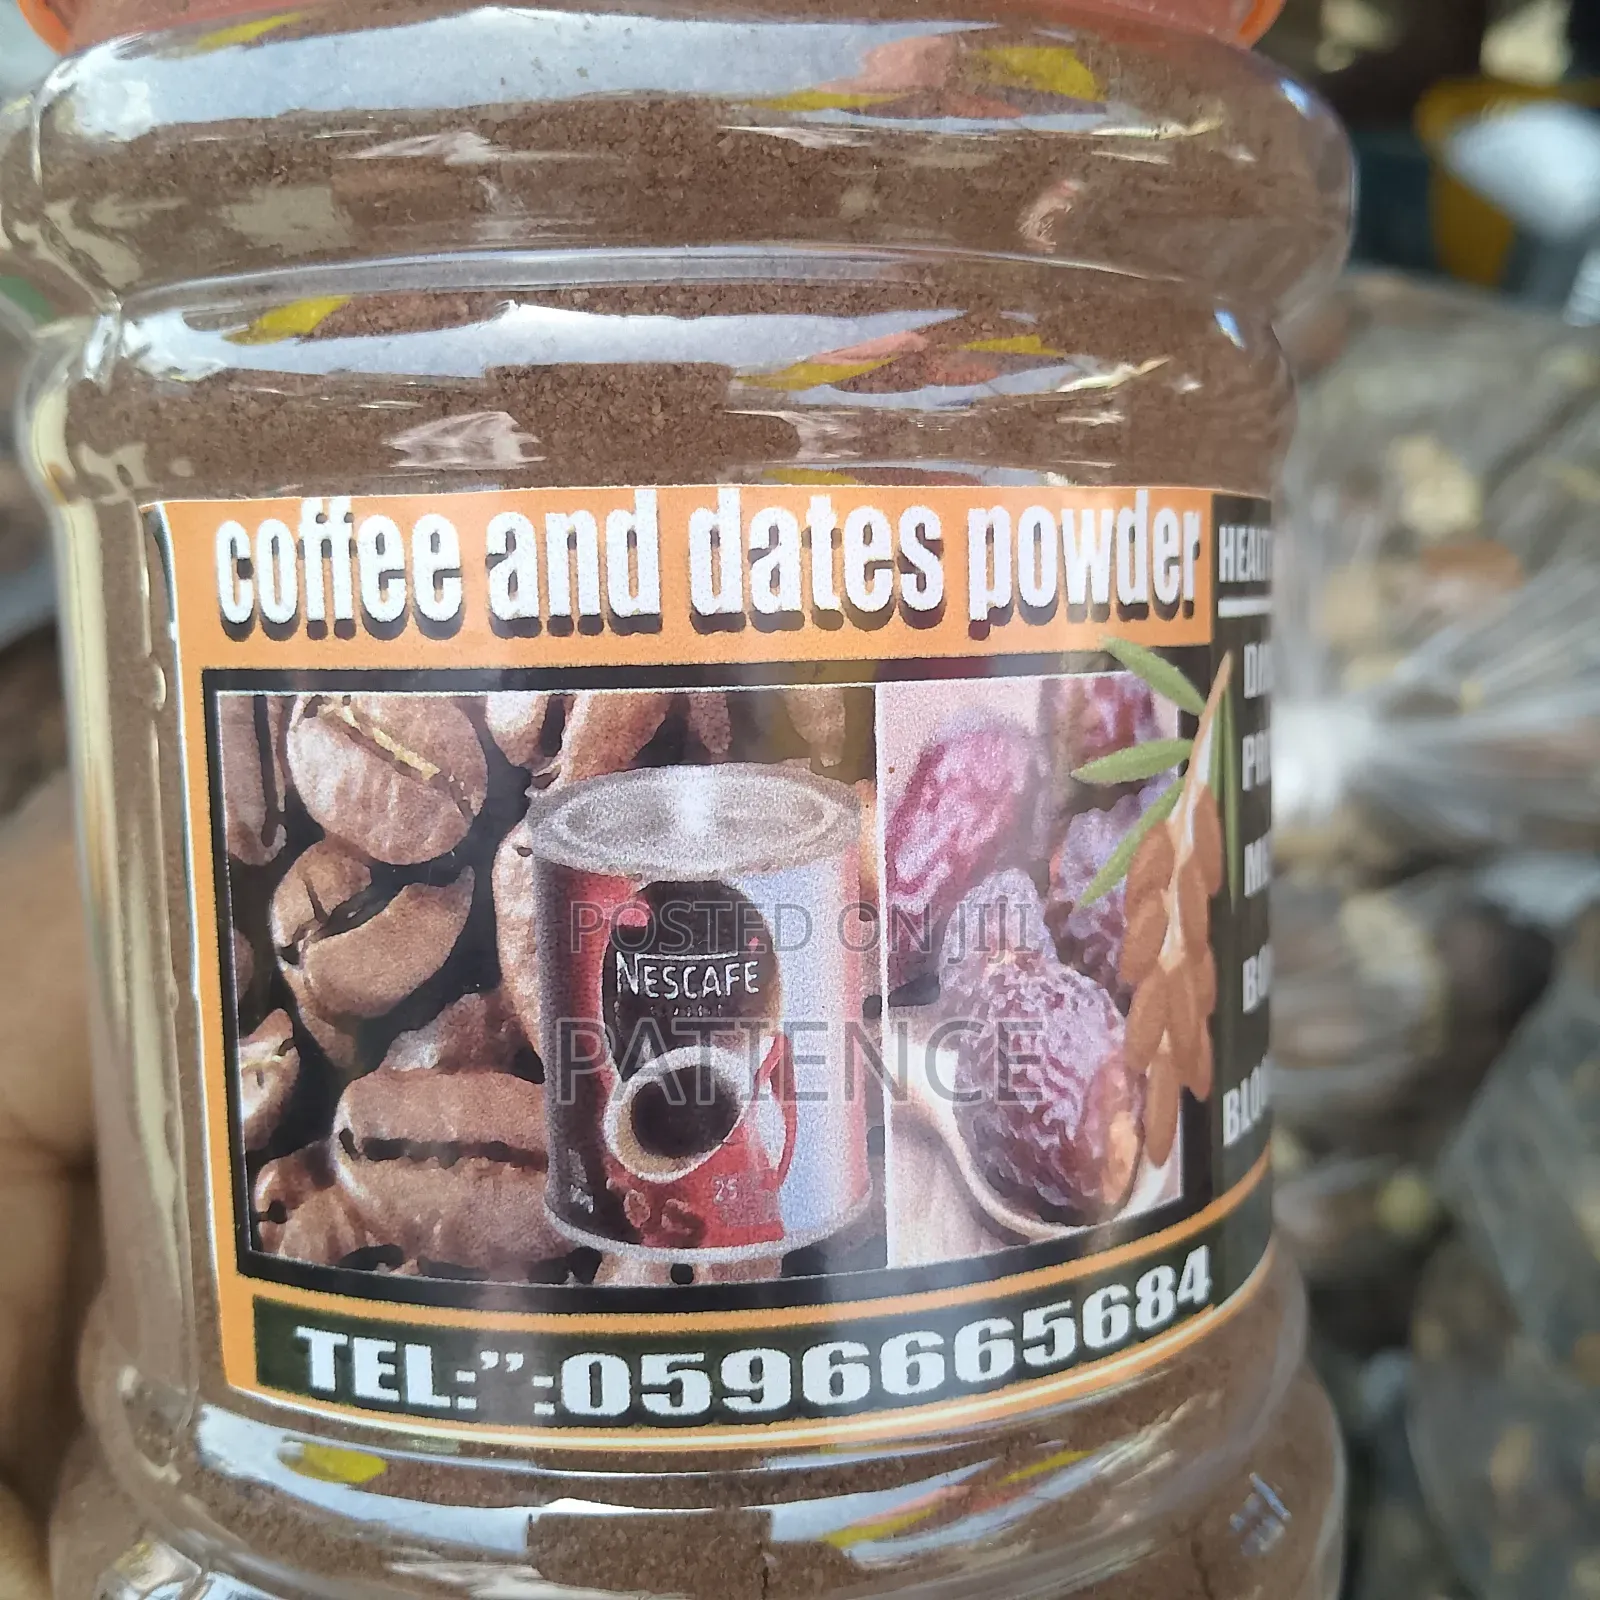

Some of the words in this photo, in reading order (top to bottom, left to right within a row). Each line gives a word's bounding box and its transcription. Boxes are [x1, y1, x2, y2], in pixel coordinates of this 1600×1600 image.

[216, 496, 464, 641] coffee
[486, 489, 664, 638] and
[689, 488, 947, 632] dates
[967, 489, 1201, 640] powder
